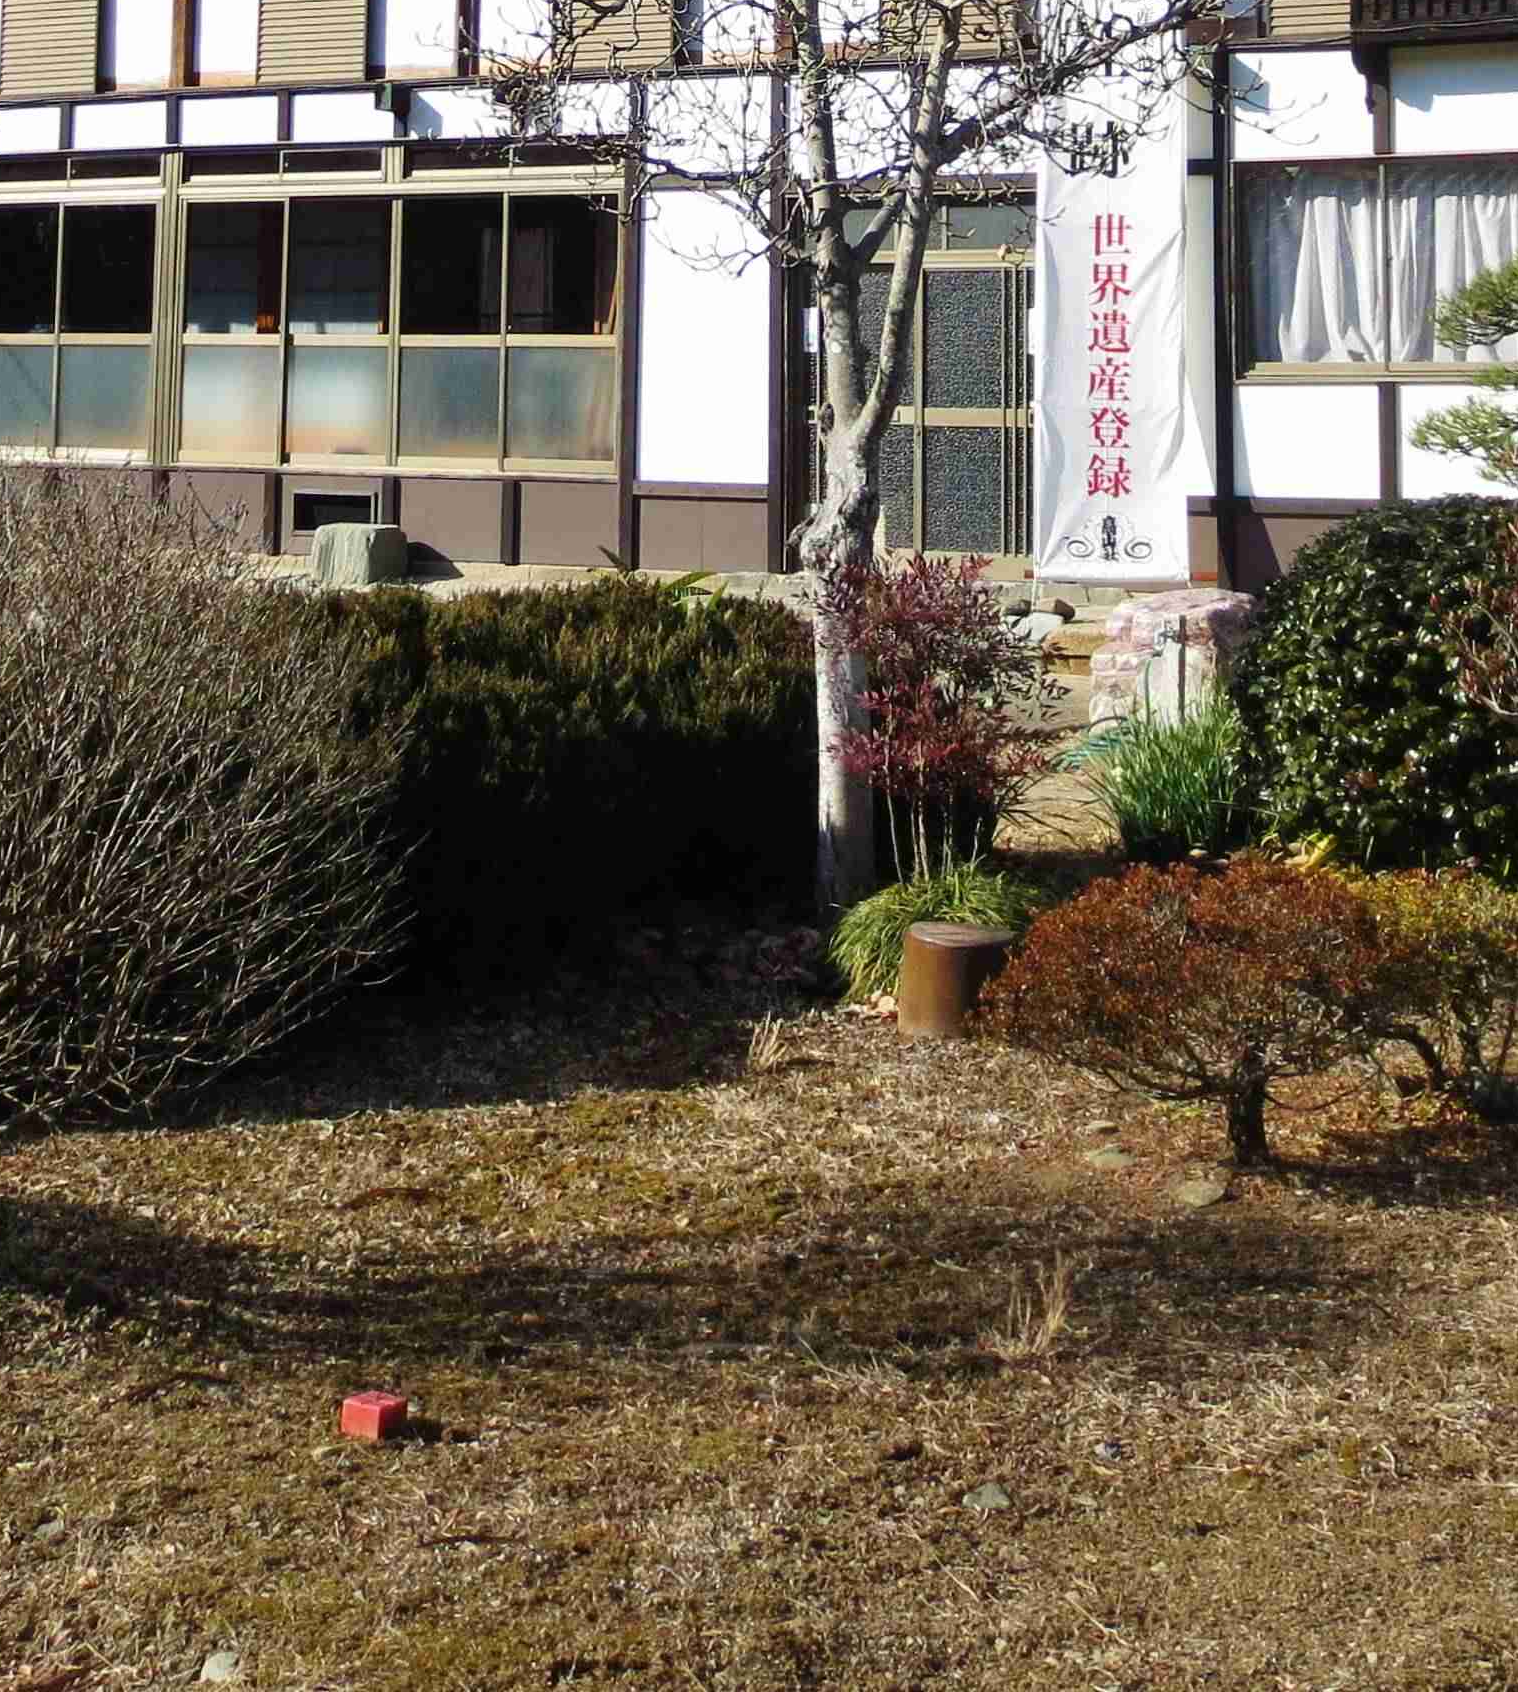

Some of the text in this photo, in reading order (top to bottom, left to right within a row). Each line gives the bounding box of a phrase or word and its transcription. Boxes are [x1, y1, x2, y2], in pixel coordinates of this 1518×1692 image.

[1087, 212, 1135, 499] 世界遺産登録
